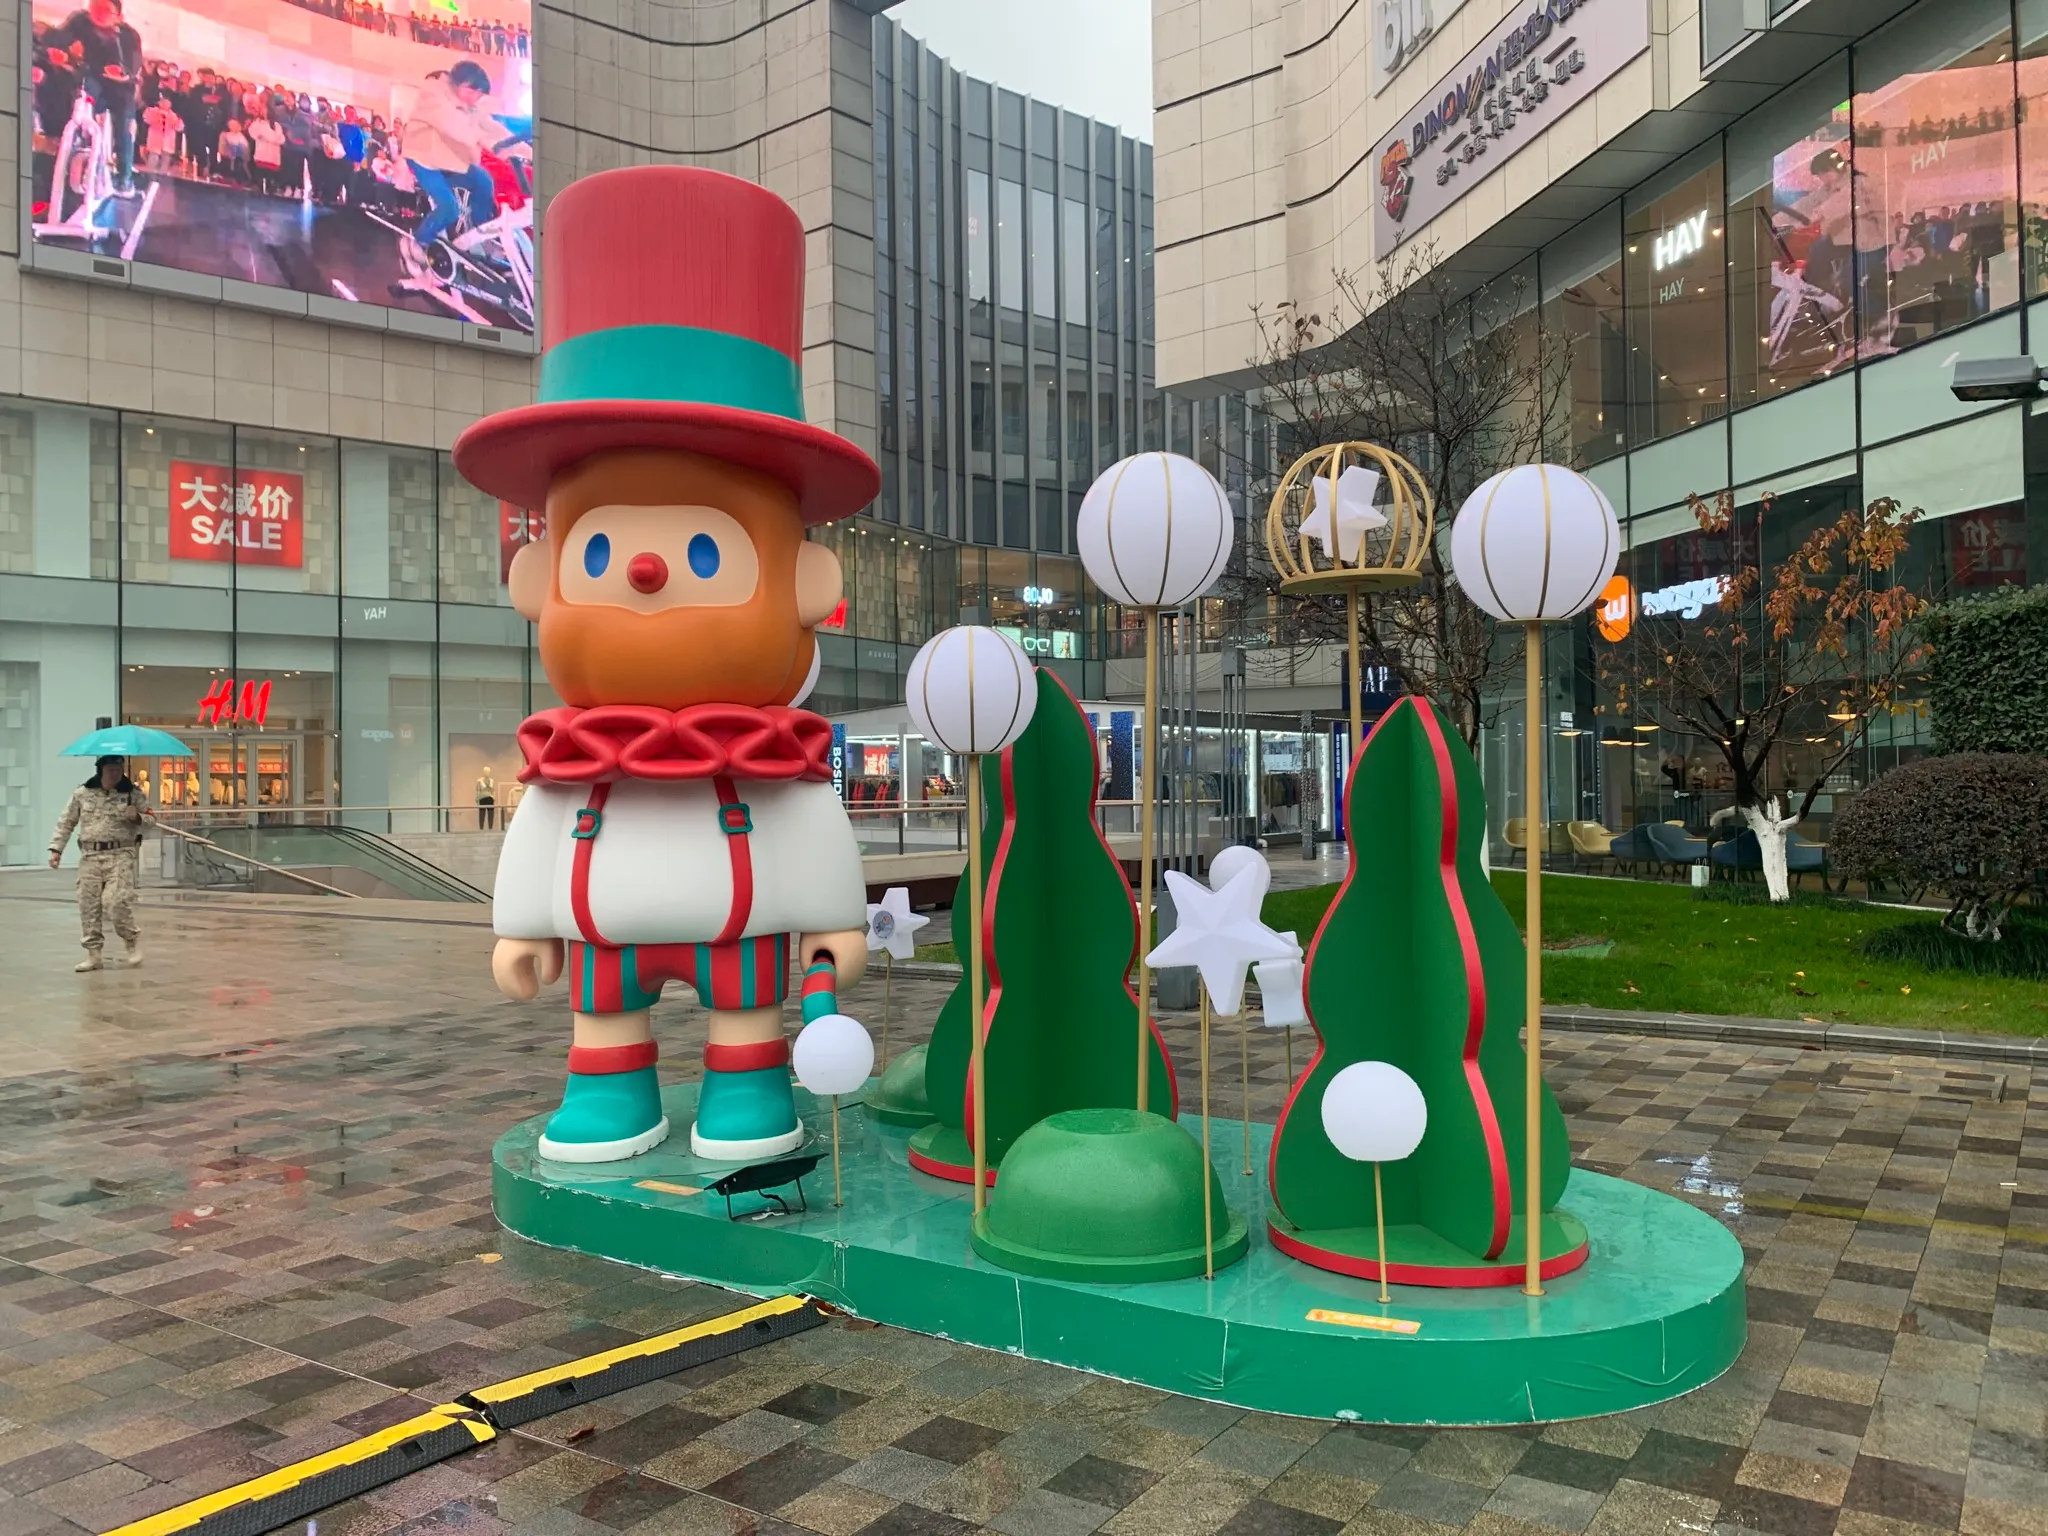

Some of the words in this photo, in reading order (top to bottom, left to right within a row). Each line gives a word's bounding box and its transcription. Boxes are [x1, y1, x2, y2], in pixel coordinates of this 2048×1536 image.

[1910, 135, 1949, 174] HAY
[1655, 209, 1708, 271] HAY
[1660, 277, 1684, 305] HAY
[180, 476, 293, 520] 大减价
[191, 515, 282, 551] SALE
[1359, 665, 1388, 693] AP
[197, 679, 272, 725] H&M
